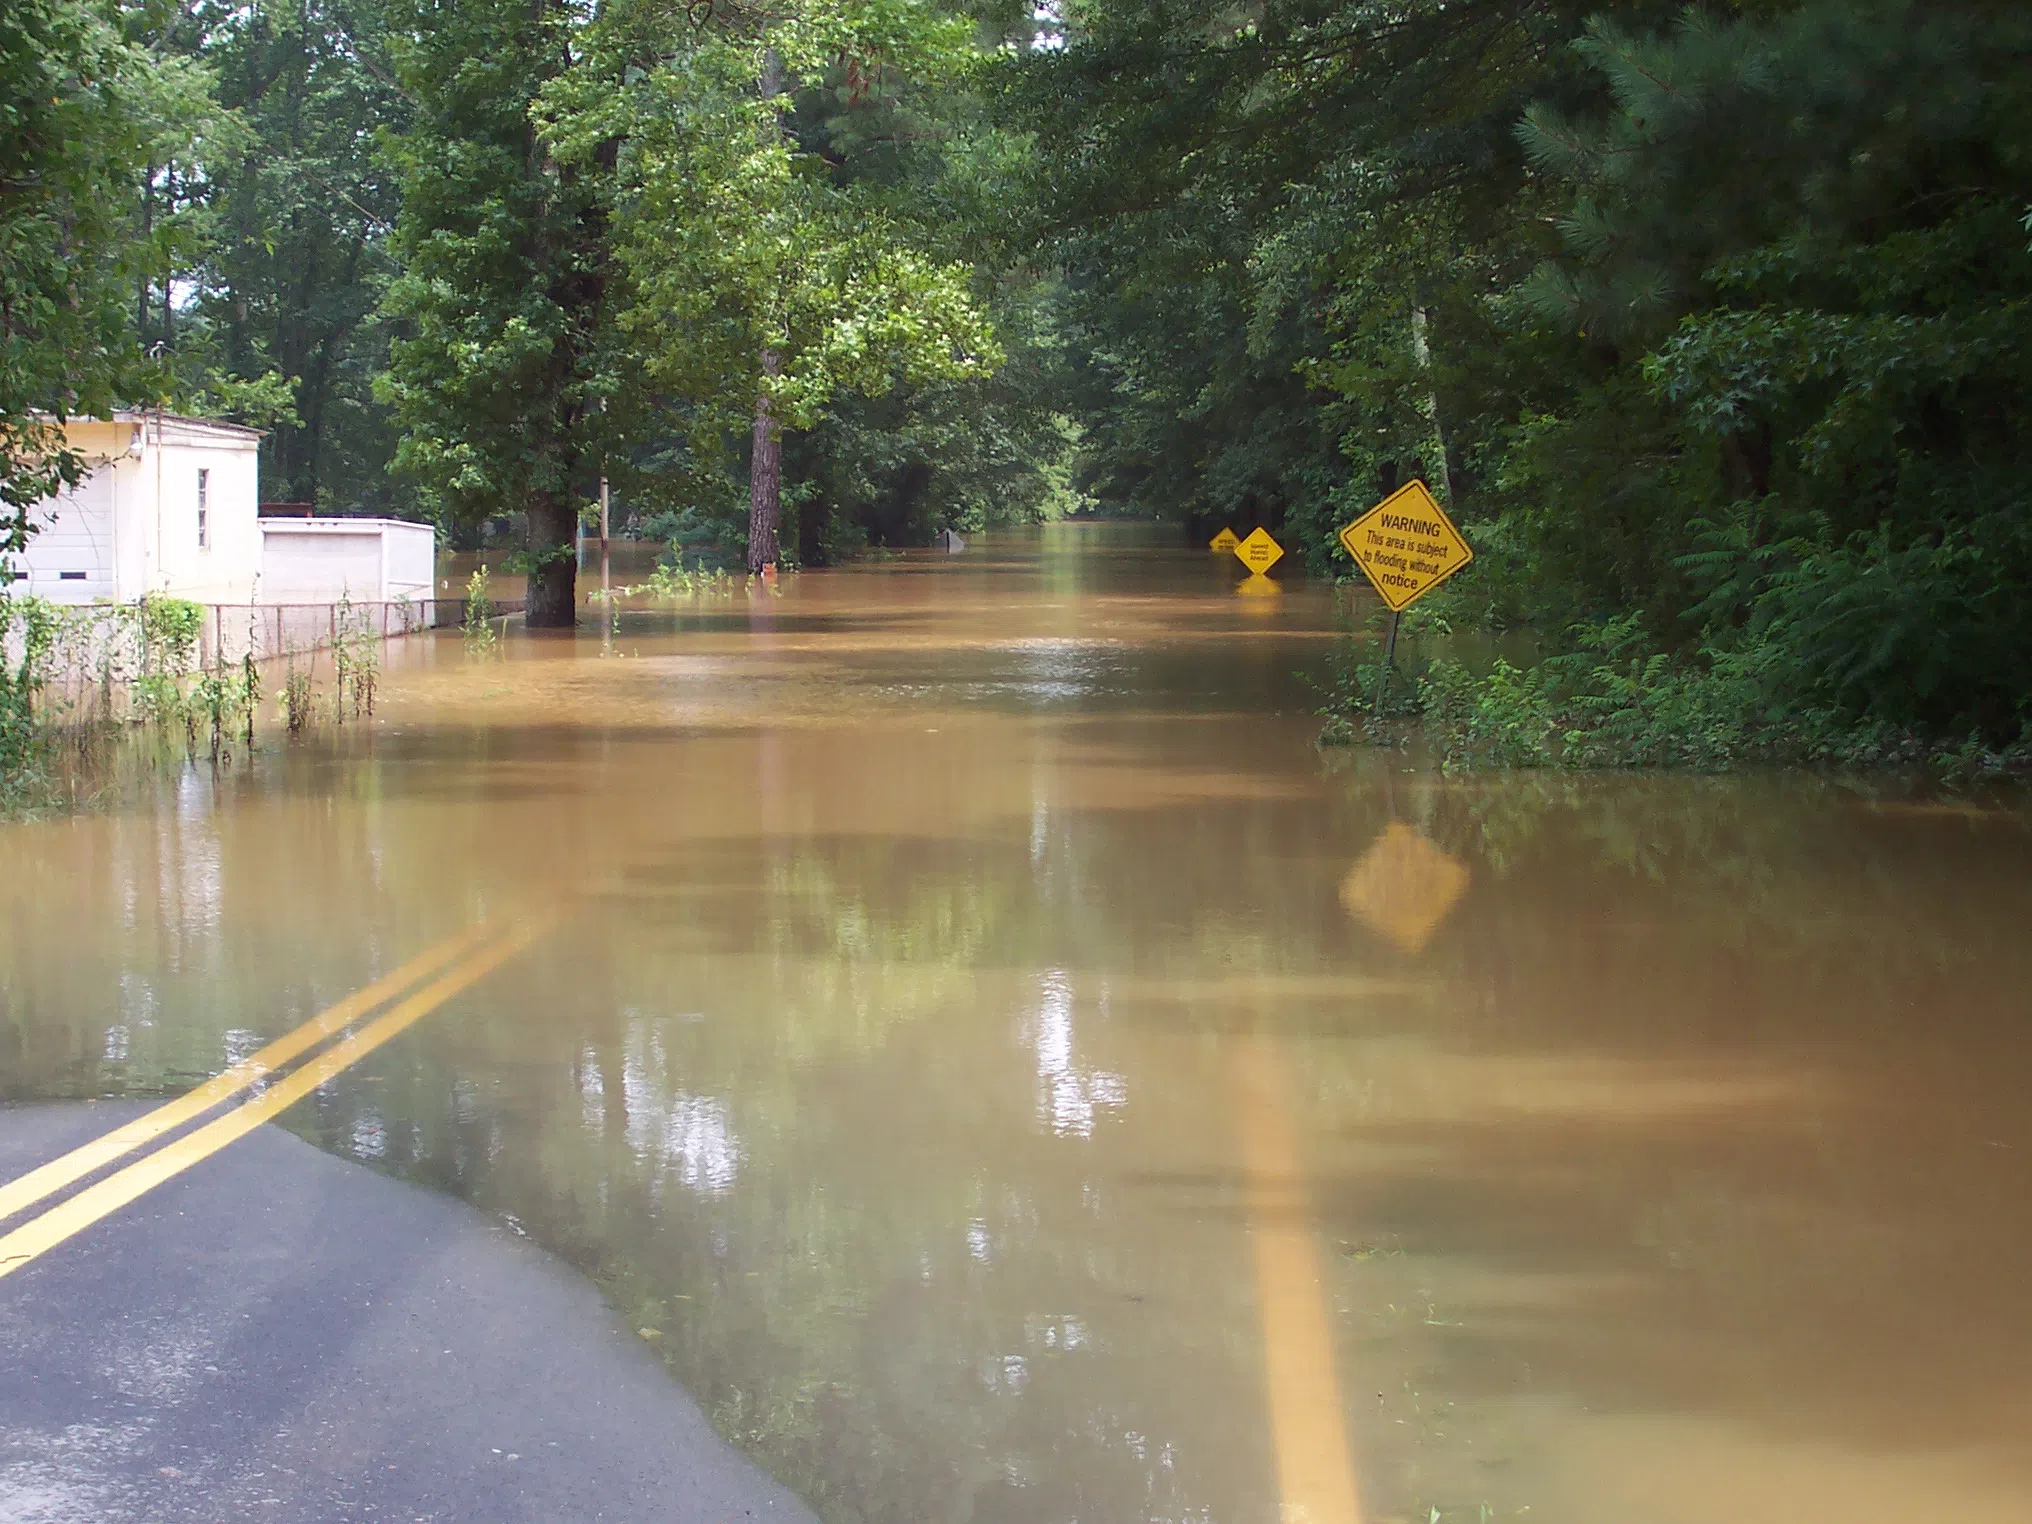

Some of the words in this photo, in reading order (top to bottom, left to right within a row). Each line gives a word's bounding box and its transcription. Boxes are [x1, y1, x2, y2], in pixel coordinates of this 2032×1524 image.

[1381, 513, 1440, 537] WARNING
[1367, 529, 1383, 546] This
[1386, 537, 1405, 550] area
[1407, 537, 1415, 552] is
[1417, 542, 1448, 558] subject
[1364, 548, 1372, 561] to
[1374, 550, 1408, 572] flooding
[1410, 557, 1439, 575] without
[1381, 573, 1418, 590] notice
